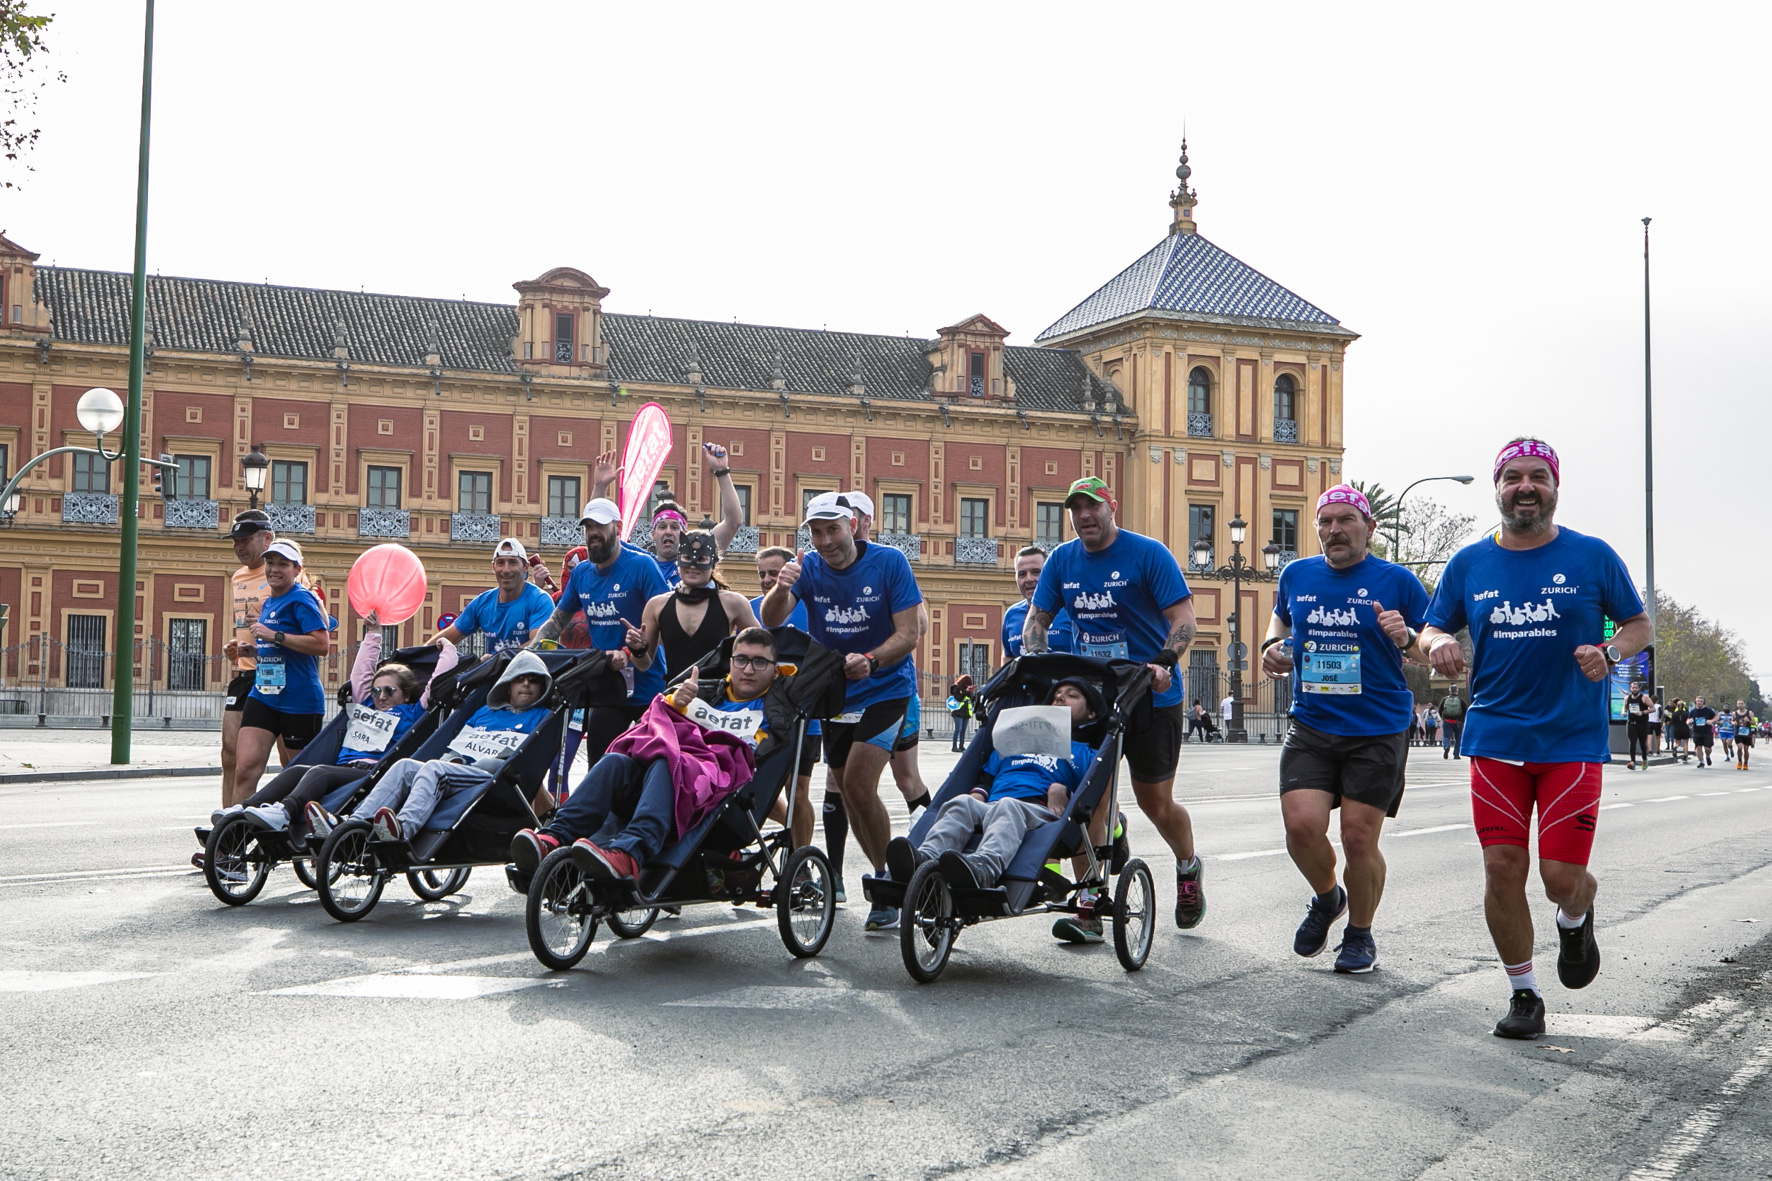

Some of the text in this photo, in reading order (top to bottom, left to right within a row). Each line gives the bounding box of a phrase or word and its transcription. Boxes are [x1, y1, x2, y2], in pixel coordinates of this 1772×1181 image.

[1473, 589, 1499, 601] aefat
[1541, 586, 1577, 595] ZURICH
[1297, 594, 1317, 602] aefat
[826, 626, 869, 634] #Imparables
[1308, 629, 1358, 638] #Imparables
[1493, 628, 1557, 640] #Imparables
[1091, 634, 1119, 642] ZURICH
[1319, 643, 1353, 652] ZURICH
[1317, 660, 1342, 669] 11503
[353, 709, 392, 732] aefat
[694, 706, 753, 730] aefat
[352, 731, 370, 744] SARA
[468, 733, 518, 747] aefat
[465, 741, 499, 755] ALVAR
